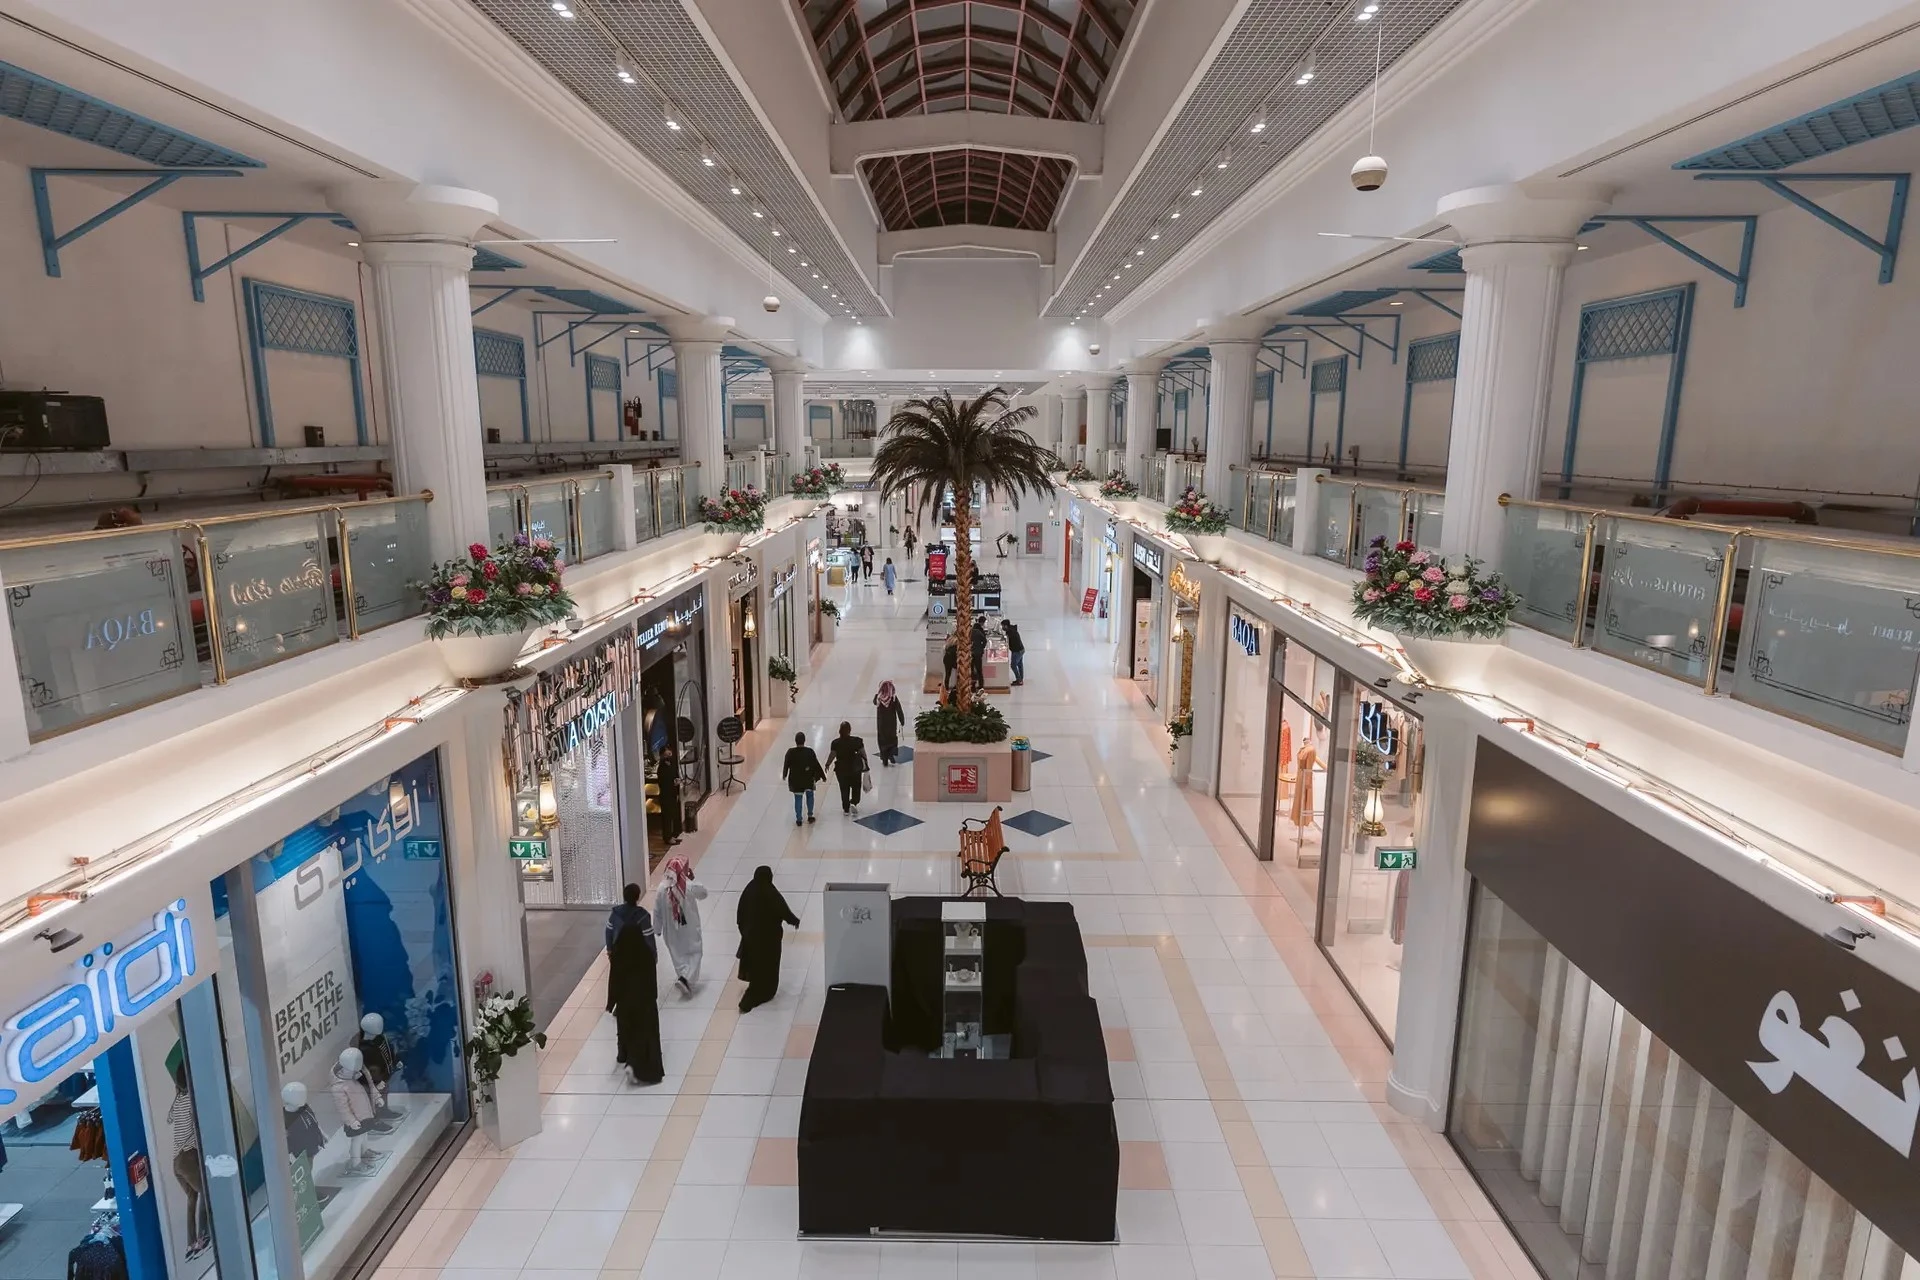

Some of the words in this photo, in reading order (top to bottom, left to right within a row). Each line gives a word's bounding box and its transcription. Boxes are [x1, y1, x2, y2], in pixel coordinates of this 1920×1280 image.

[1231, 614, 1261, 656] BAQA
[547, 691, 616, 764] SWAROVSKI
[275, 970, 335, 1032] BETTER
[277, 1010, 312, 1054] FOR
[314, 982, 344, 1019] THE
[280, 1007, 340, 1075] PLANET
